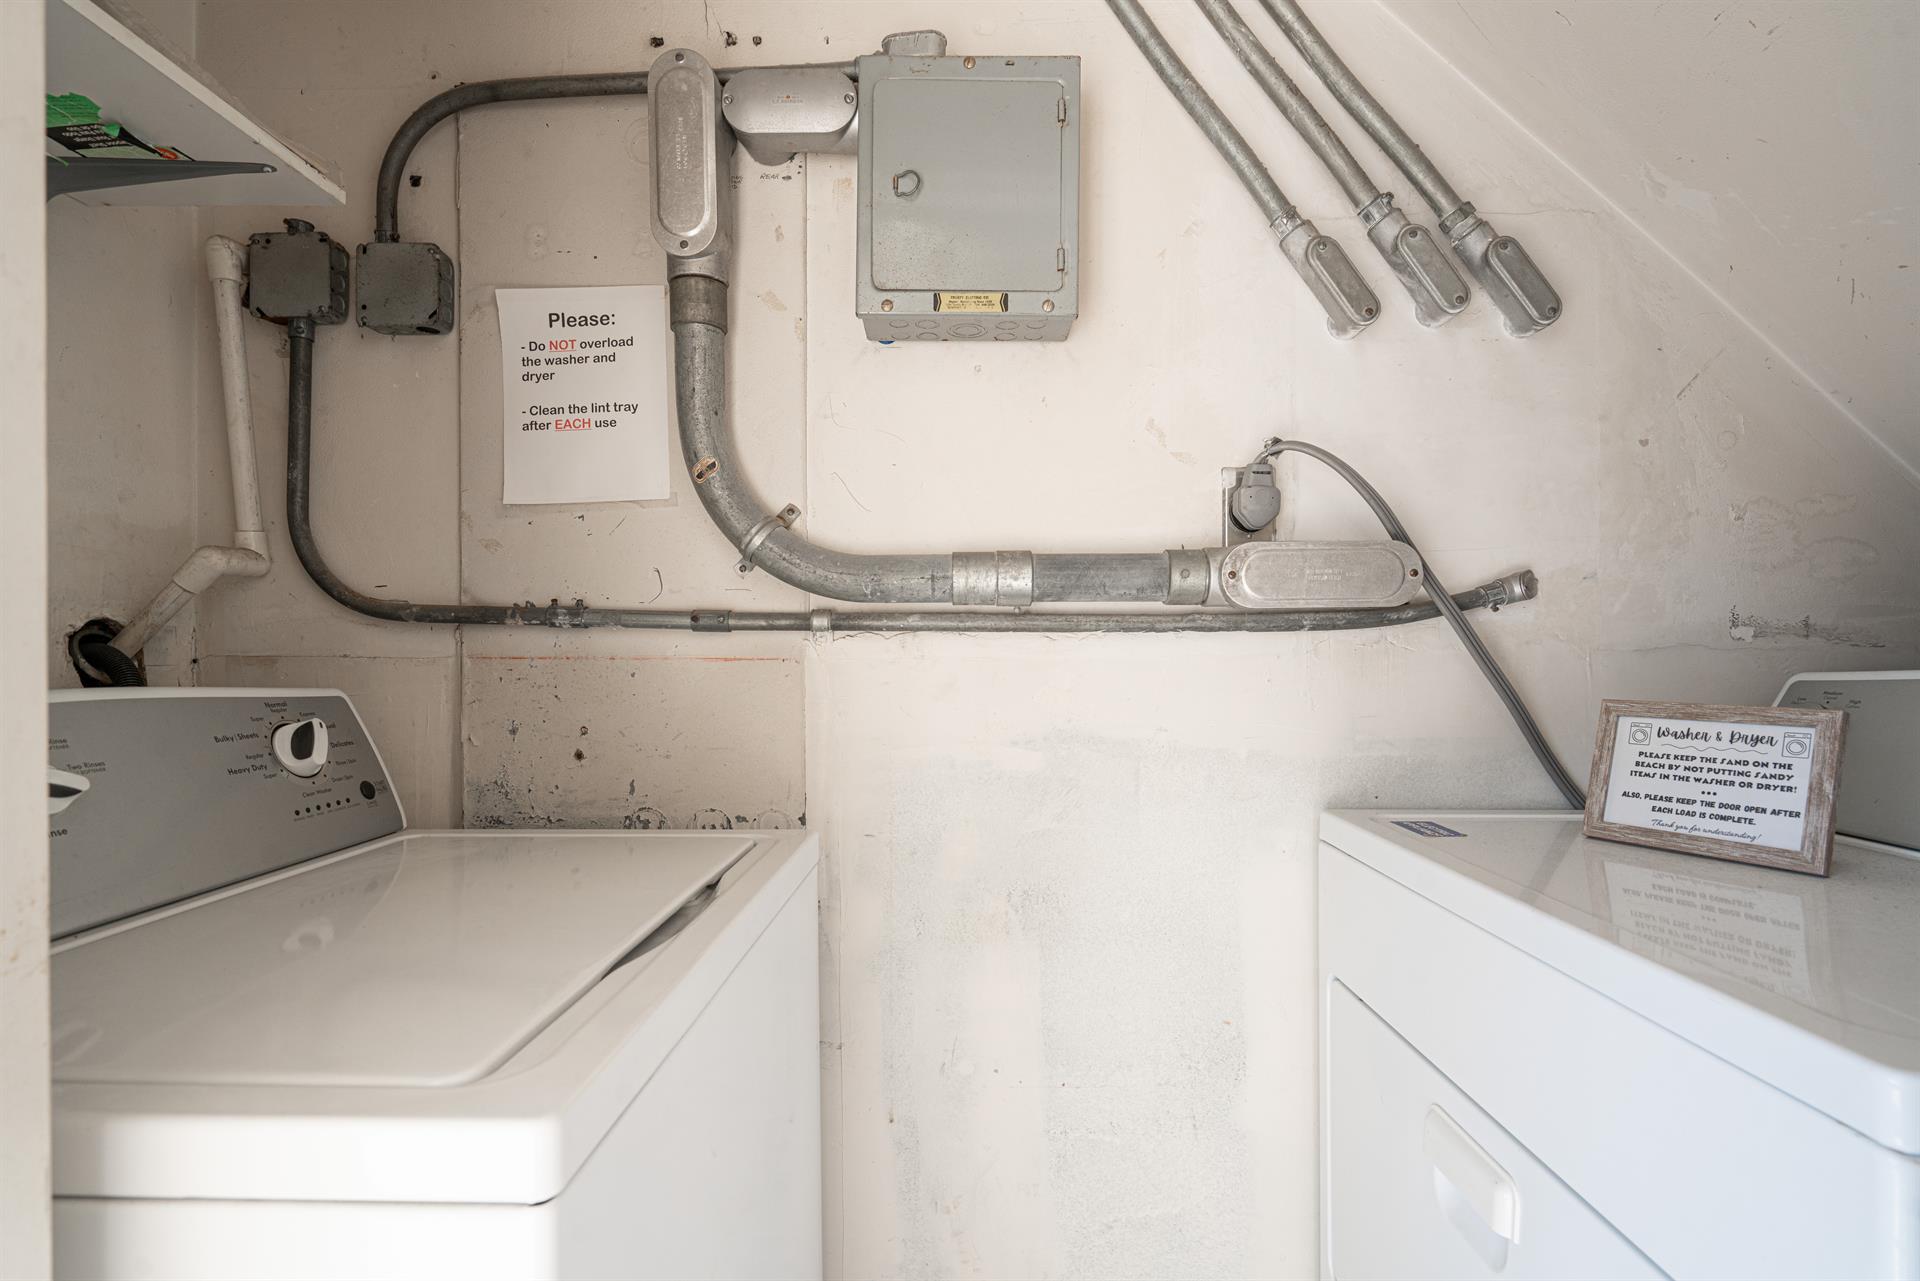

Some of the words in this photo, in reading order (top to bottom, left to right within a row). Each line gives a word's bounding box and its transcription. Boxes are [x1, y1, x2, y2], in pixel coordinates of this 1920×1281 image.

[548, 312, 616, 329] Please:
[528, 341, 546, 352] Do
[549, 339, 577, 351] NOT
[579, 336, 634, 349] overload
[521, 356, 542, 367] the
[544, 354, 590, 366] washer
[593, 352, 616, 363] and
[521, 371, 556, 383] dryer
[529, 405, 565, 416] Clean
[568, 403, 588, 414] the
[591, 402, 611, 413] lint
[613, 402, 639, 415] tray
[521, 420, 552, 432] after
[554, 418, 592, 430] EACH
[594, 418, 617, 428] use
[1656, 726, 1712, 743] Washer
[1715, 730, 1723, 742] &
[1729, 730, 1779, 747] Dryer
[227, 766, 251, 776] Heavy
[251, 763, 268, 772] Duty
[1638, 751, 1671, 761] PLEASE
[1673, 753, 1697, 762] KEEP
[1700, 756, 1718, 765] THE
[1719, 757, 1750, 767] SAND
[1752, 760, 1769, 769] ON
[1772, 761, 1793, 771] THE
[1634, 760, 1666, 771] BEACH
[1667, 763, 1681, 772] BY
[1683, 765, 1704, 774] NOT
[1706, 767, 1751, 778] PUTTING
[1753, 771, 1795, 782] SANDY
[1629, 770, 1657, 779] ITEMS
[1659, 772, 1671, 780] IN
[1673, 773, 1691, 782] THE
[1693, 776, 1736, 787] WASHER
[1738, 780, 1753, 789] OR
[1756, 782, 1798, 794] DRYER!
[1621, 790, 1643, 800] ALSO,
[1644, 793, 1674, 804] PLEASE
[1676, 797, 1697, 806] KEEP
[1700, 800, 1716, 809] THE
[1718, 802, 1742, 812] DOOR
[1744, 805, 1768, 815] OPEN
[1769, 808, 1801, 819] AFTER
[1651, 805, 1673, 815] EACH
[1675, 808, 1697, 818] LOAD
[1699, 810, 1706, 819] IS
[1709, 811, 1757, 826] COMPLETE.
[1651, 818, 1674, 829] Thank
[1675, 823, 1689, 833] you
[1689, 823, 1702, 834] for
[1702, 826, 1762, 843] understanding!
